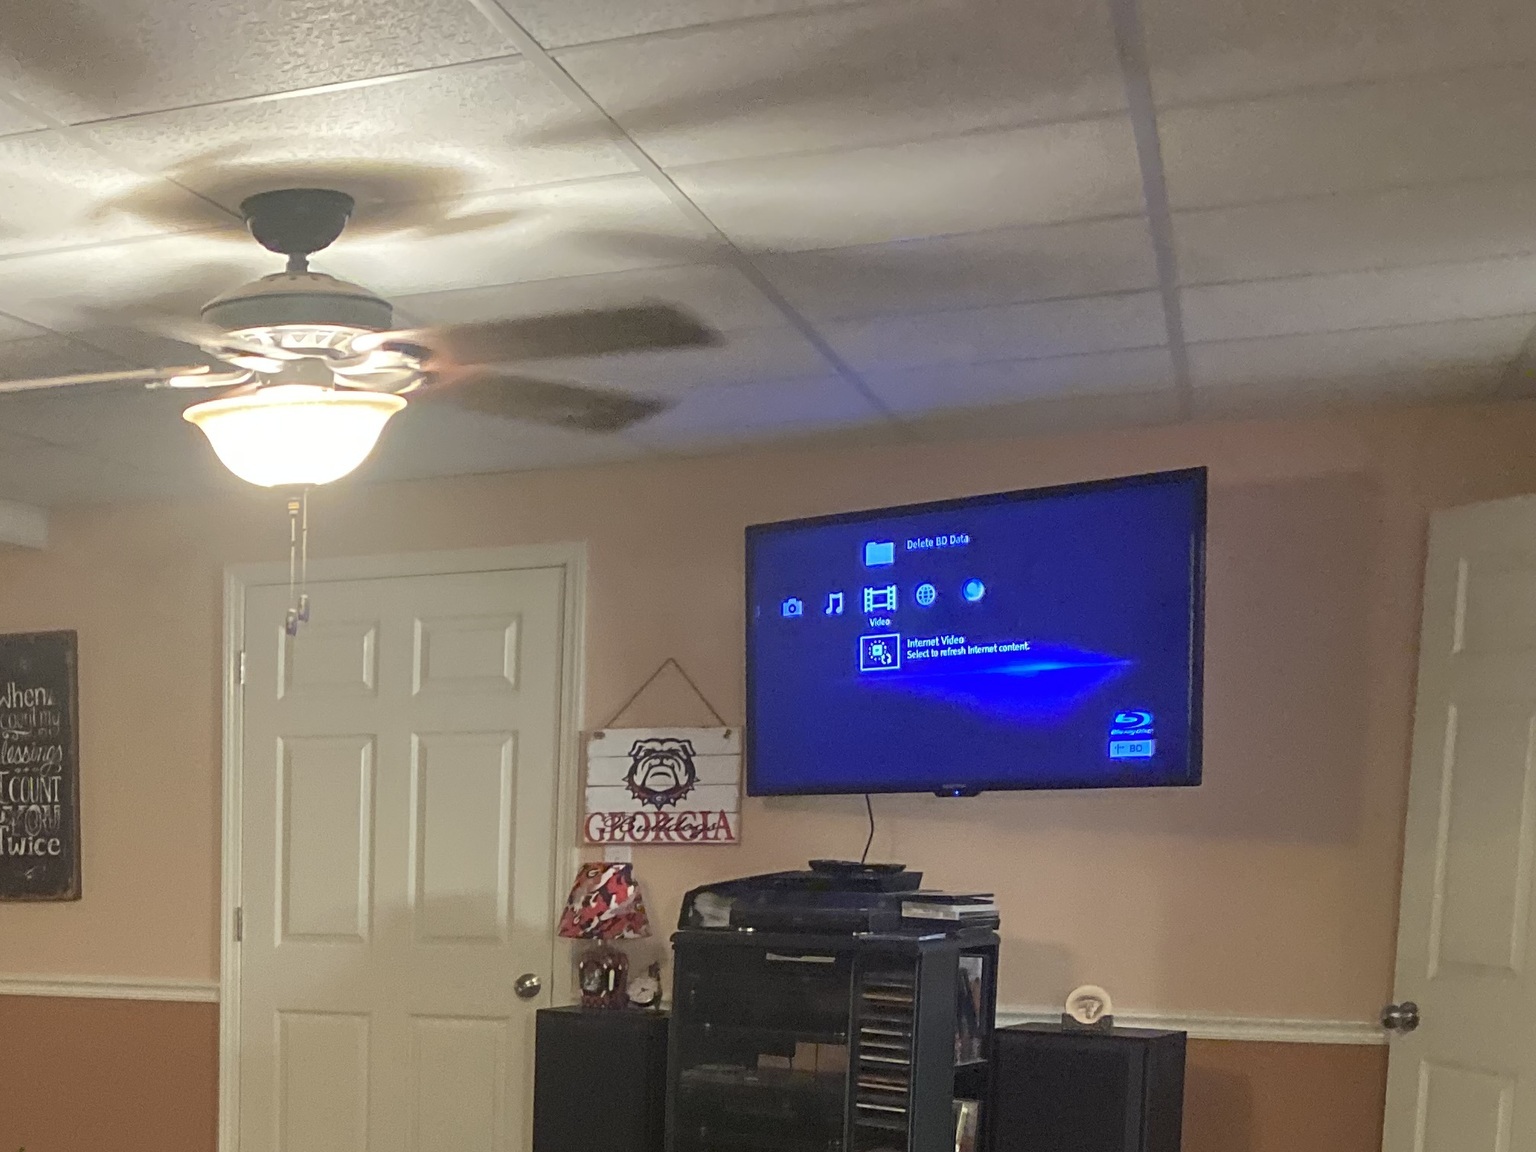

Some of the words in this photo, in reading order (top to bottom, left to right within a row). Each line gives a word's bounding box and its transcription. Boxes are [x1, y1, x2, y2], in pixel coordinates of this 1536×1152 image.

[907, 537, 934, 549] Delete
[936, 536, 948, 546] BD
[950, 534, 970, 545] Data
[869, 616, 891, 627] Video
[907, 637, 939, 648] Internet
[941, 635, 965, 646] Video
[907, 649, 930, 659] Select
[931, 649, 939, 657] to
[940, 646, 966, 657] refresh
[968, 643, 997, 655] Internet
[1129, 744, 1143, 753] BD
[9, 776, 61, 803] COUNT
[584, 809, 735, 842] GEORGIA
